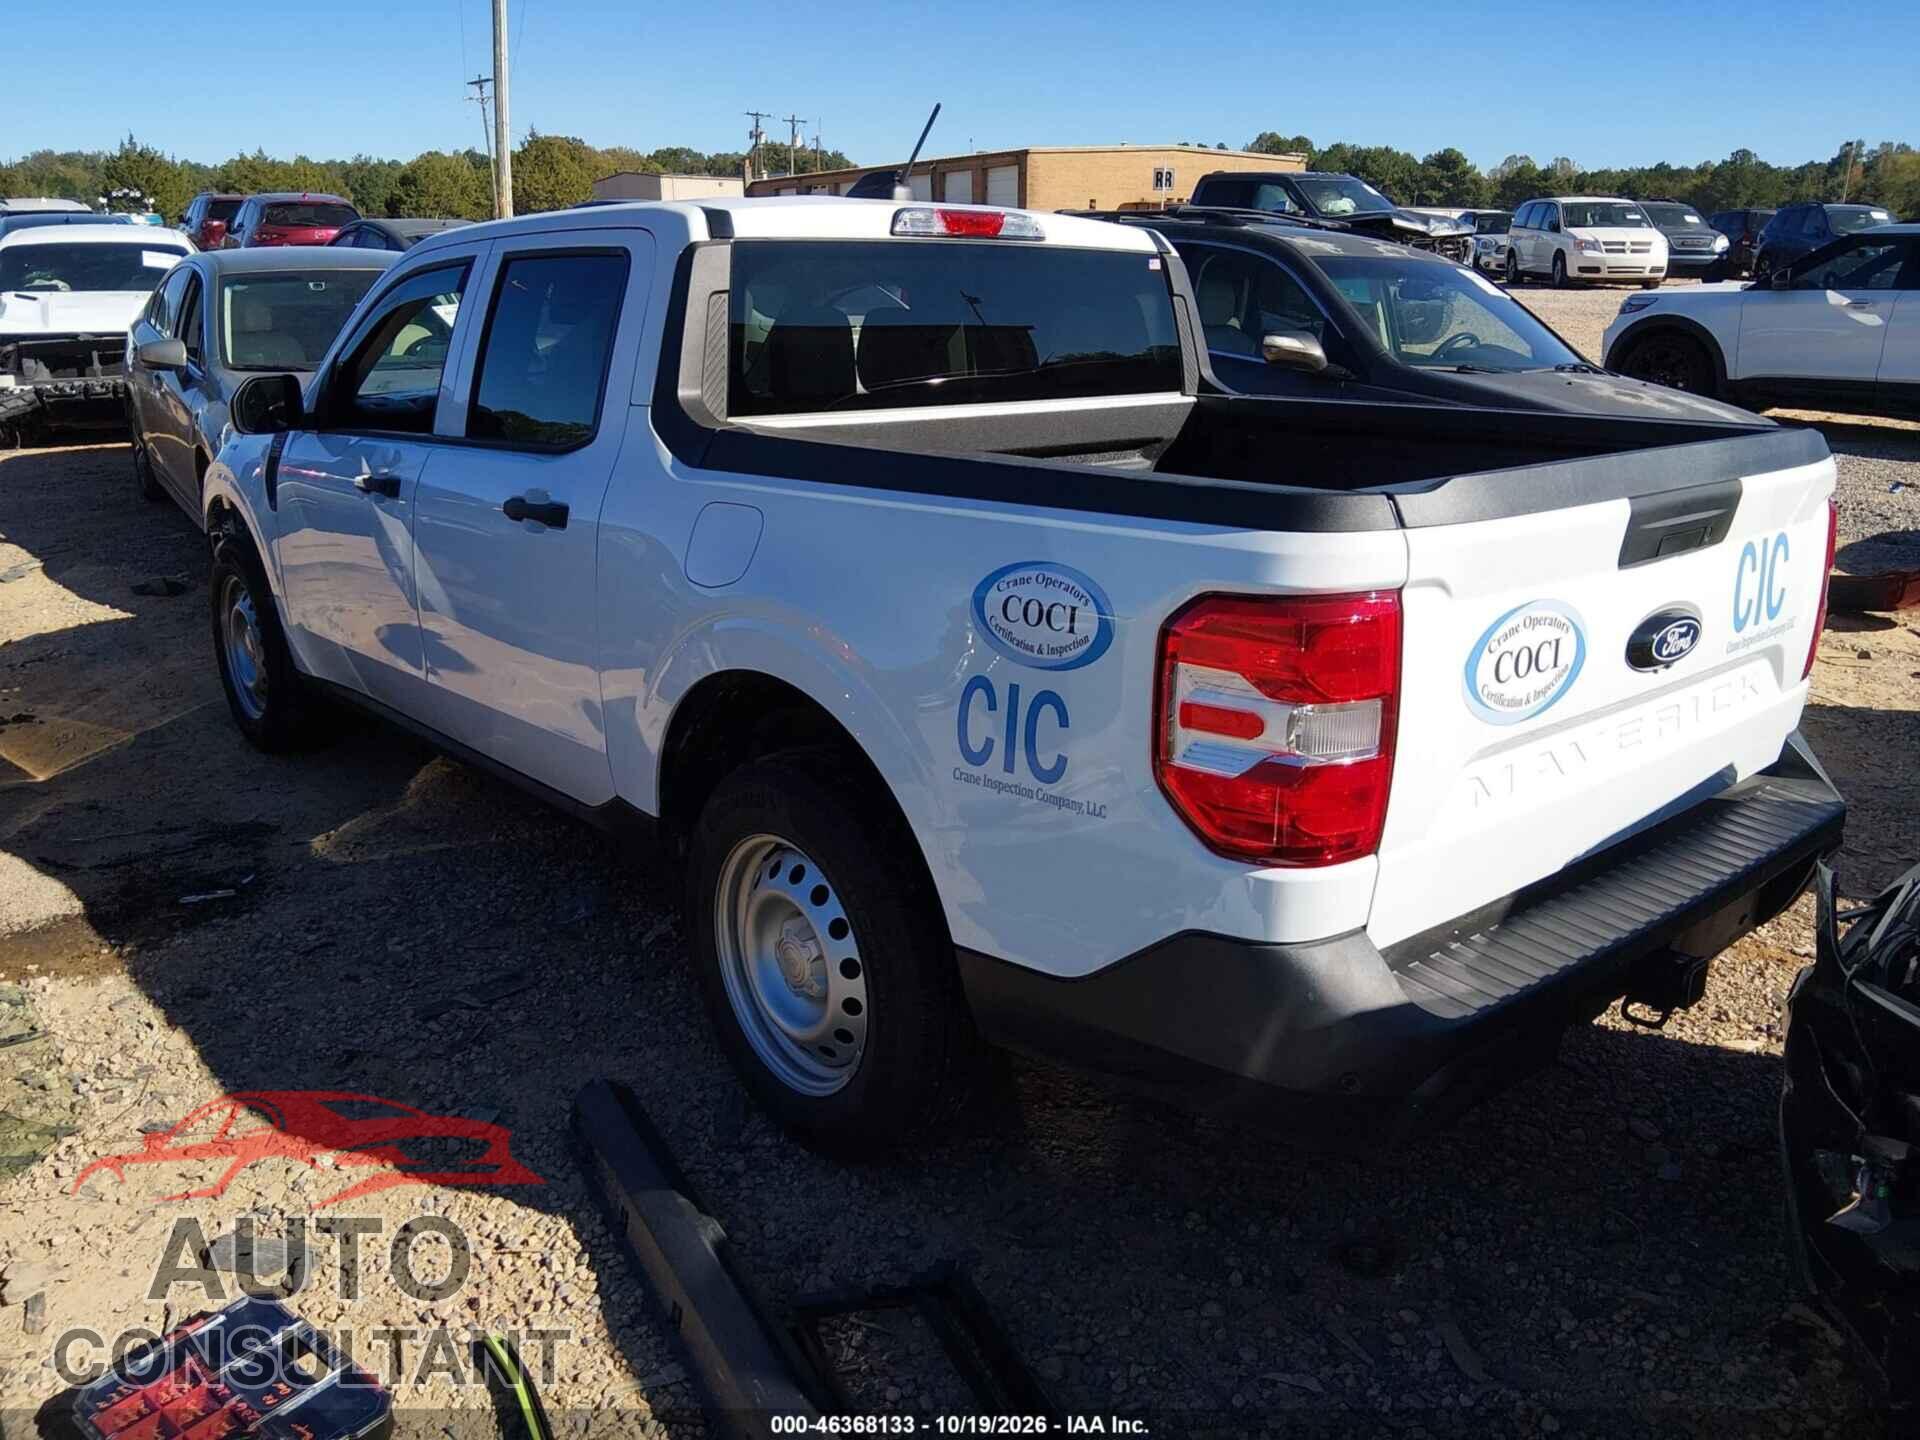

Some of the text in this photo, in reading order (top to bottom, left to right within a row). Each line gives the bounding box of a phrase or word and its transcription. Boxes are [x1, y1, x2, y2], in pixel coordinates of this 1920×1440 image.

[996, 572, 1091, 607] Crane Operators
[1733, 531, 1790, 634] CIC
[1001, 594, 1080, 635] COCI
[1487, 615, 1571, 655] Crane Operators
[989, 615, 1090, 657] Certification & Inspection
[1661, 625, 1695, 657] Ford
[1494, 637, 1562, 684] COCI
[957, 674, 1070, 785] CIC
[952, 767, 1107, 819] Crane Inspection Company, LLC
